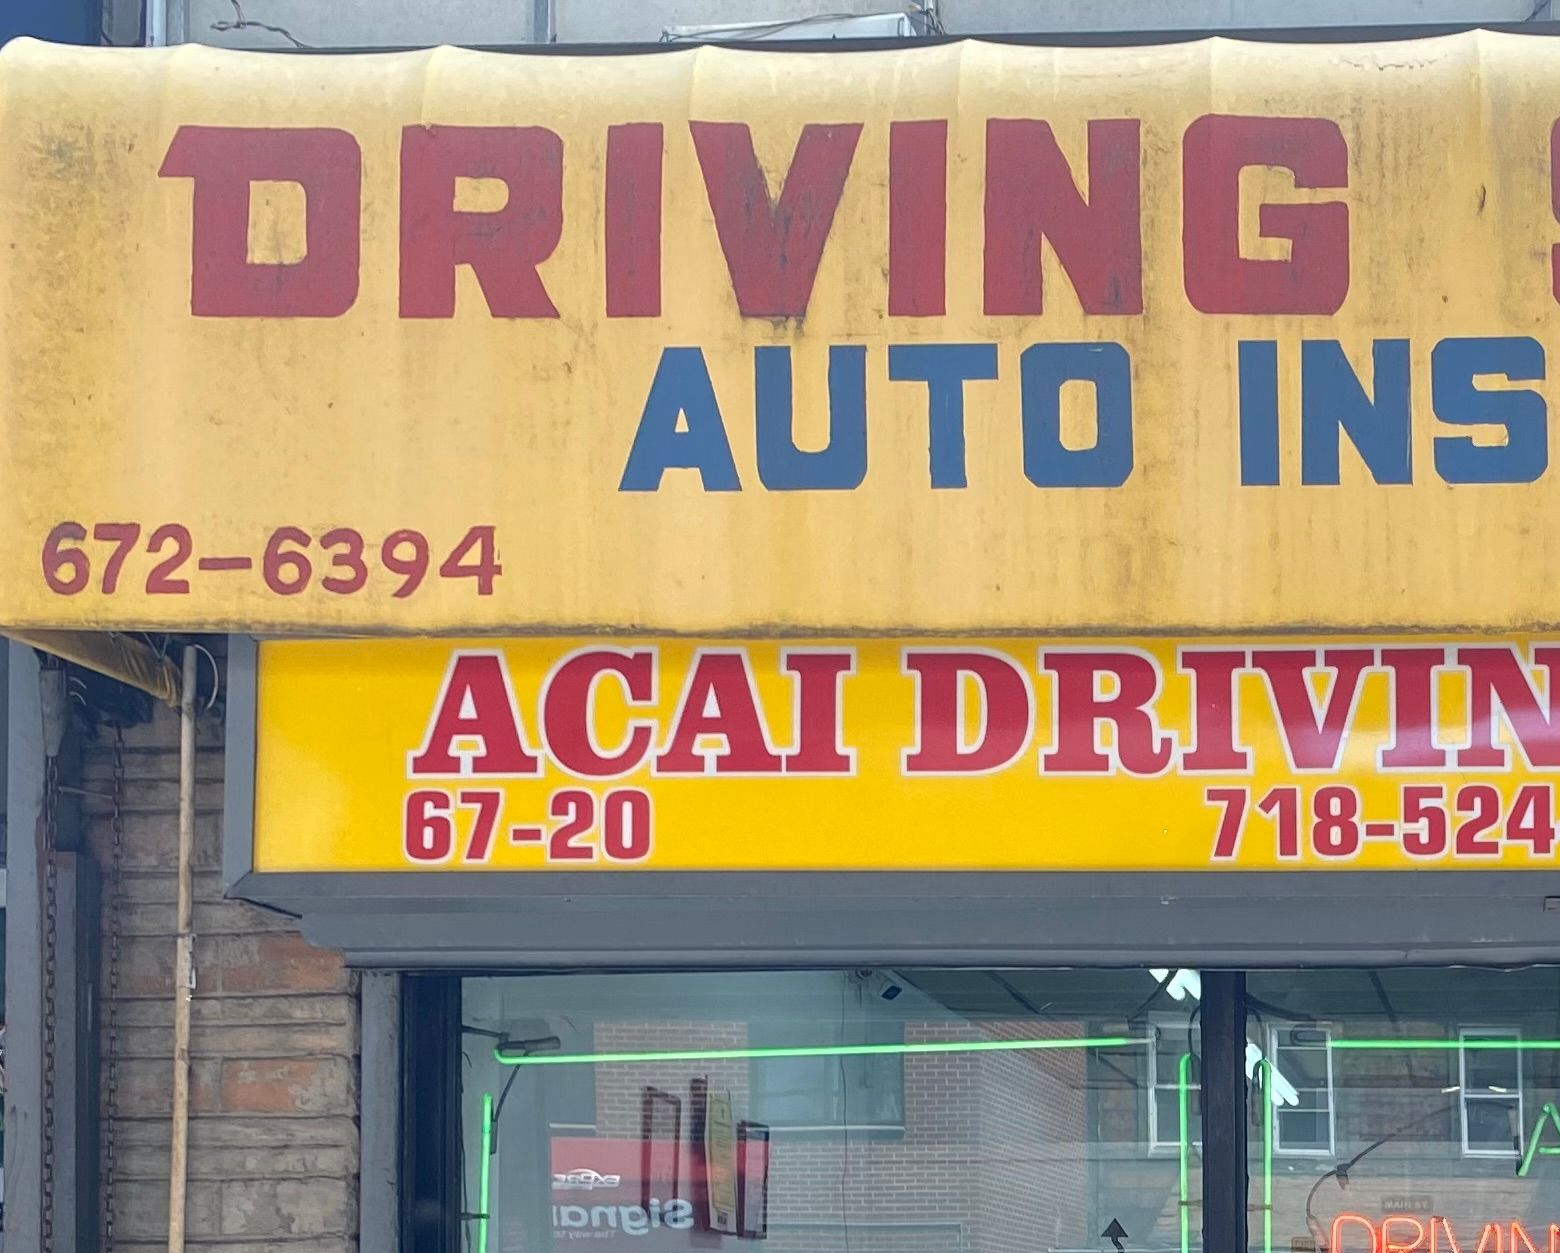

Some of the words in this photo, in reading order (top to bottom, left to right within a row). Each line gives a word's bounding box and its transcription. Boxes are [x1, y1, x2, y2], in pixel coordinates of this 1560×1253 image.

[158, 113, 1350, 319] DRIVING
[618, 342, 1133, 491] AUTO
[41, 521, 502, 599] 672-6394
[408, 647, 856, 778] ACAI
[403, 788, 653, 863] 67-20
